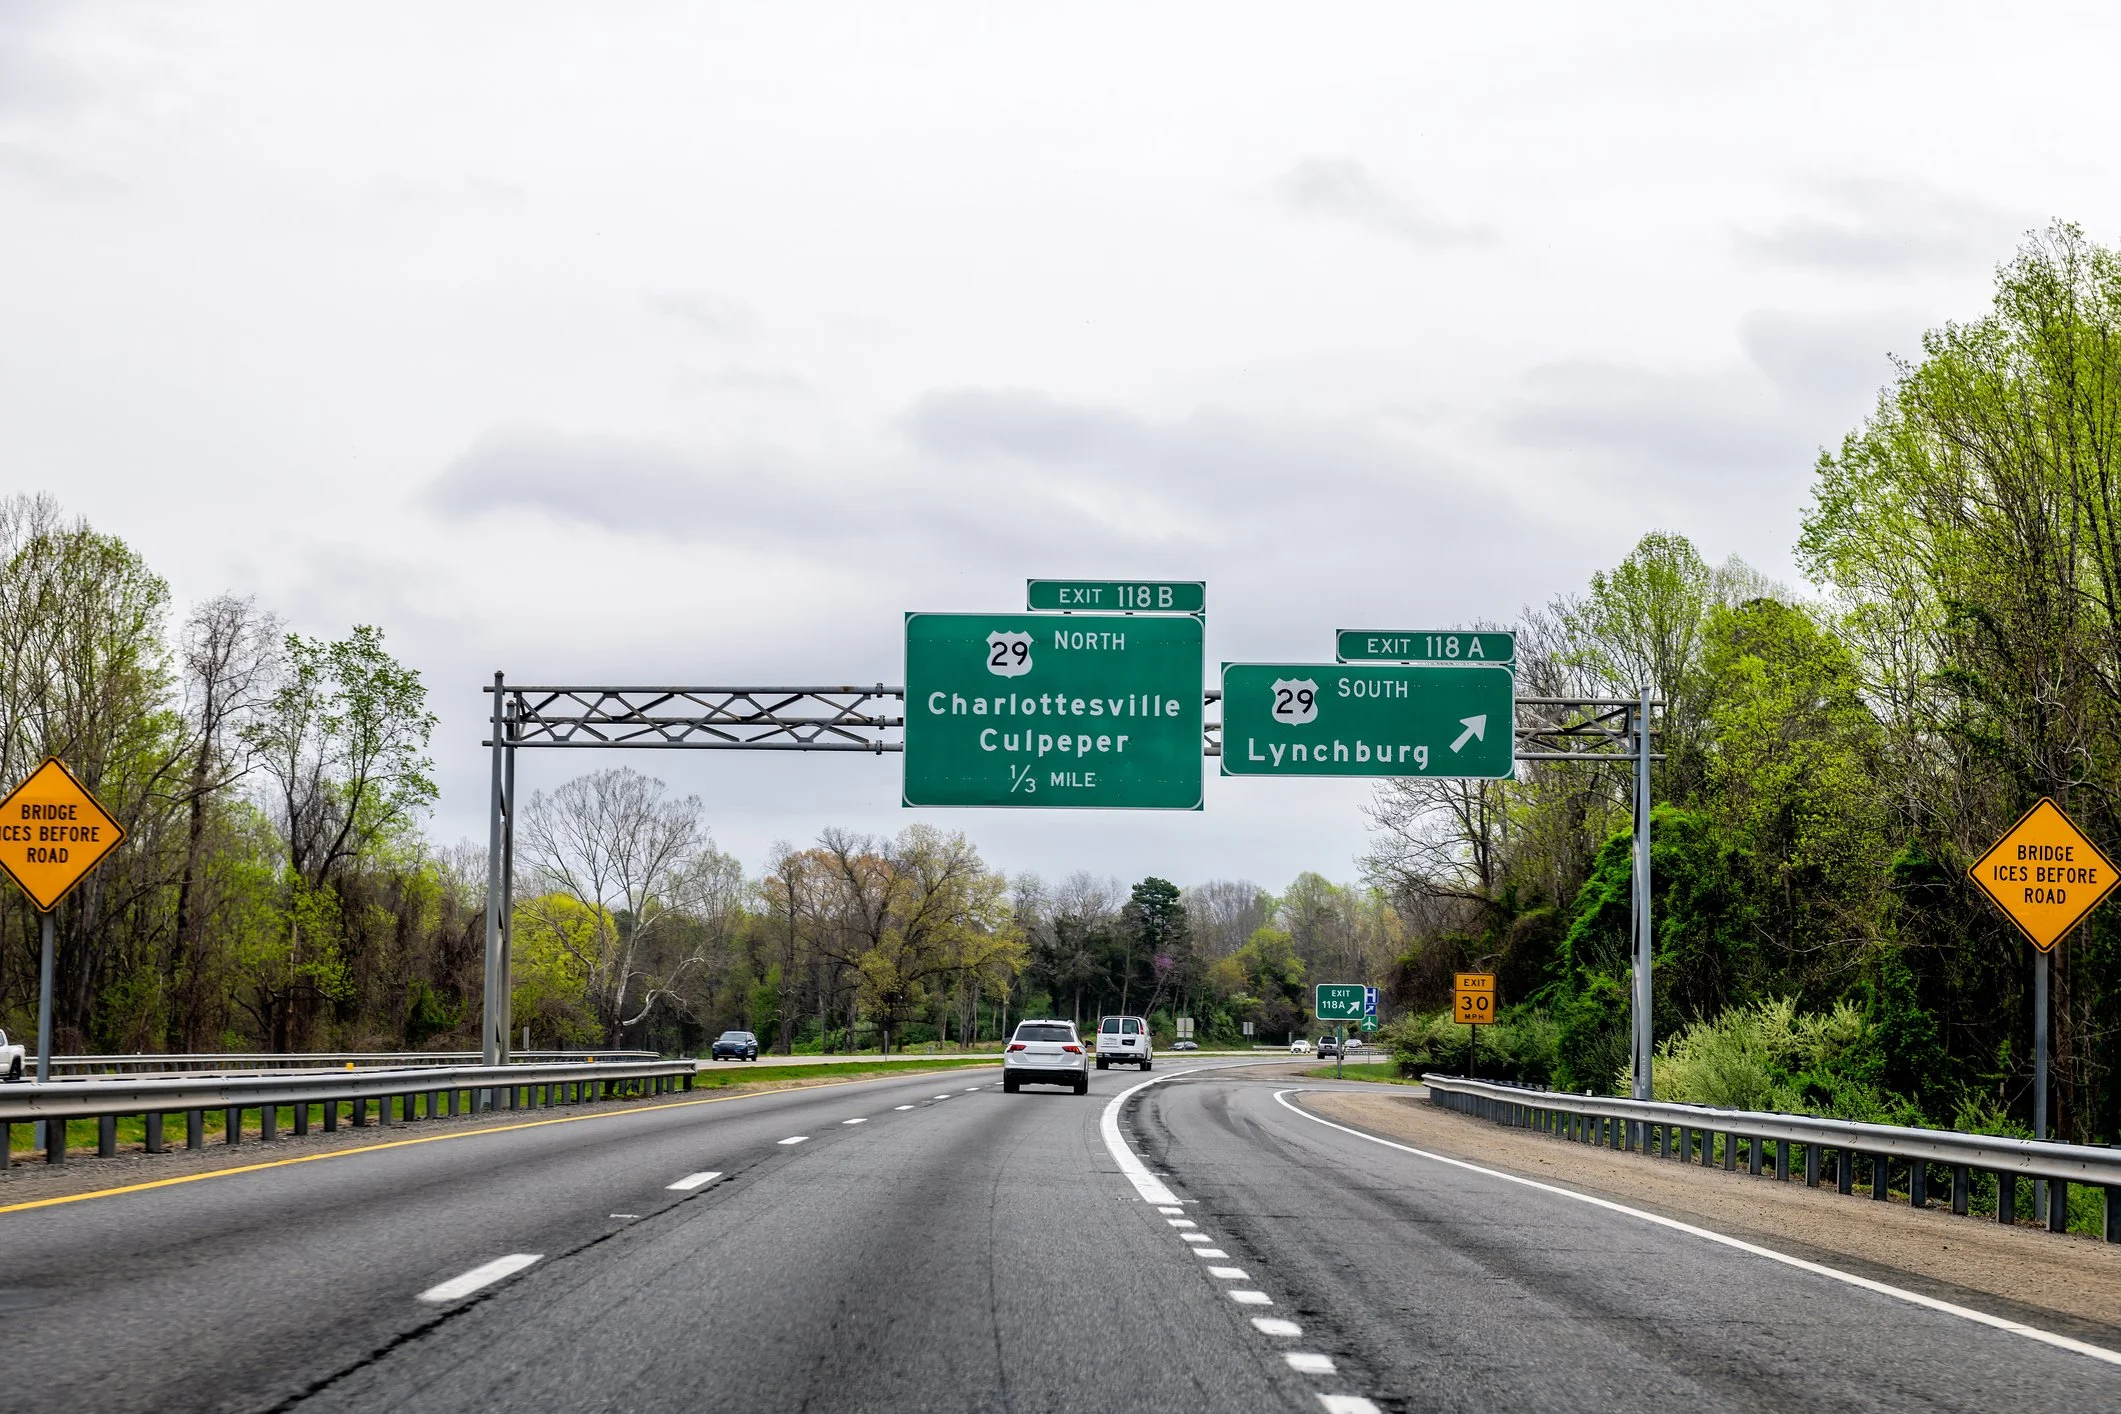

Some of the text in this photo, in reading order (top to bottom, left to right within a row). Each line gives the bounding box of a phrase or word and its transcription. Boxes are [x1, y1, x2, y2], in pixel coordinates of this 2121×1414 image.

[1059, 588, 1102, 603] EXIT
[1054, 630, 1125, 650] NORTH
[1367, 638, 1410, 653] EXIT
[991, 641, 1028, 666] 29
[1338, 677, 1408, 698] SOUTH
[928, 691, 1180, 716] Charlottesville
[1276, 688, 1314, 714] 29
[980, 728, 1129, 758] Culpeper
[1249, 738, 1429, 770] Lynchburg
[1050, 772, 1095, 787] MILE
[21, 804, 77, 820] BRIDGE
[39, 826, 100, 842] BEFORE
[27, 847, 69, 863] ROAD
[2017, 844, 2074, 862] BRIDGE
[1993, 865, 2097, 884] ICES BEFORE
[2024, 887, 2066, 904] ROAD
[1463, 978, 1487, 987] EXIT
[1322, 1001, 1345, 1009] 118A
[1461, 996, 1489, 1011] 30
